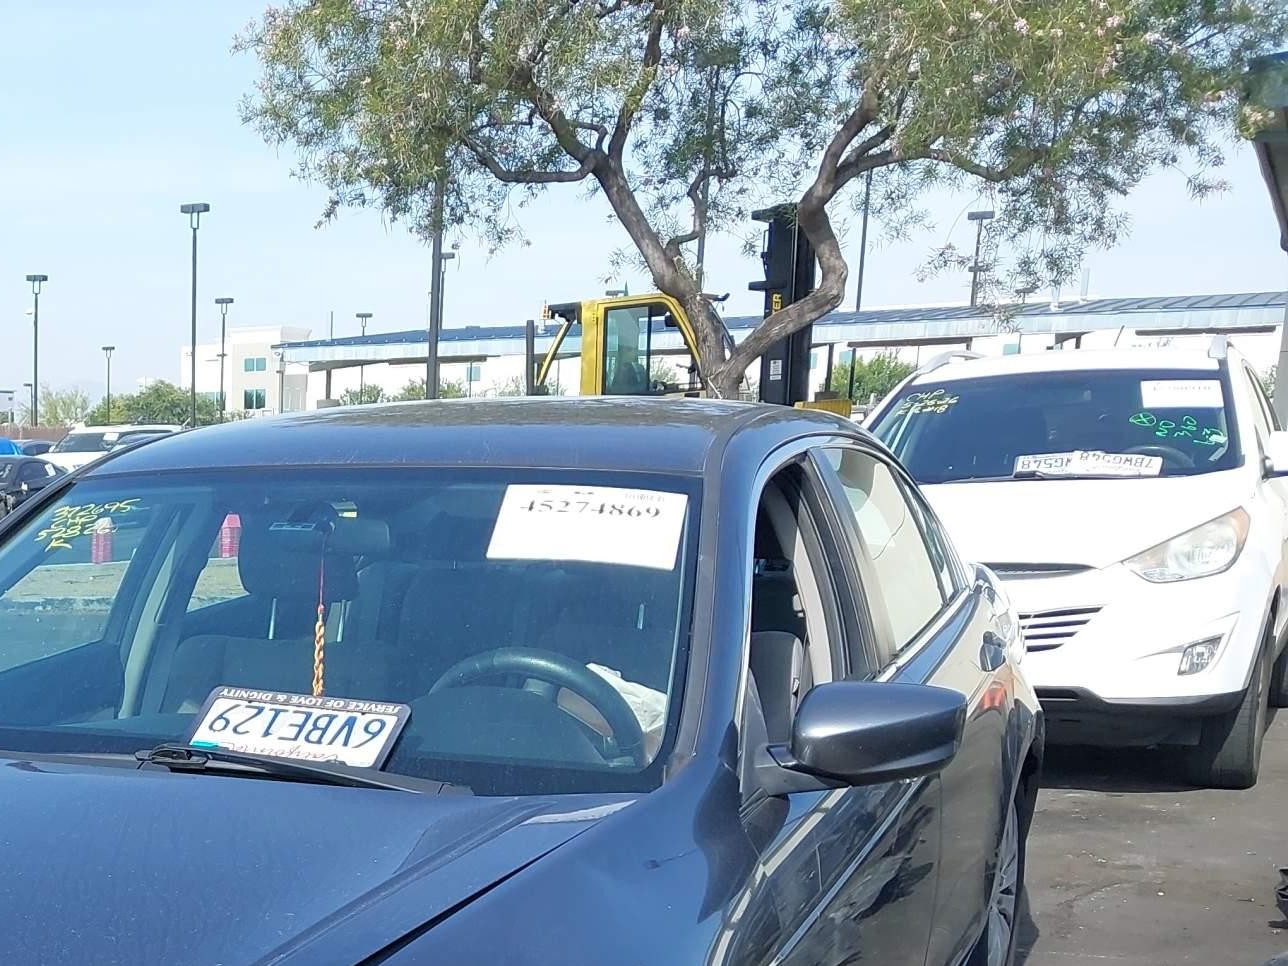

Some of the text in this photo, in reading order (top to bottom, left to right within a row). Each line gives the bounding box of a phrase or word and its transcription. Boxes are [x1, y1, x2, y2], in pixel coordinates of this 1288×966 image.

[519, 500, 661, 517] 45274869
[50, 514, 98, 529] CHP
[219, 687, 403, 714] SERVICE OF LOVE & DIGNITY
[207, 703, 388, 749] 6VBE129
